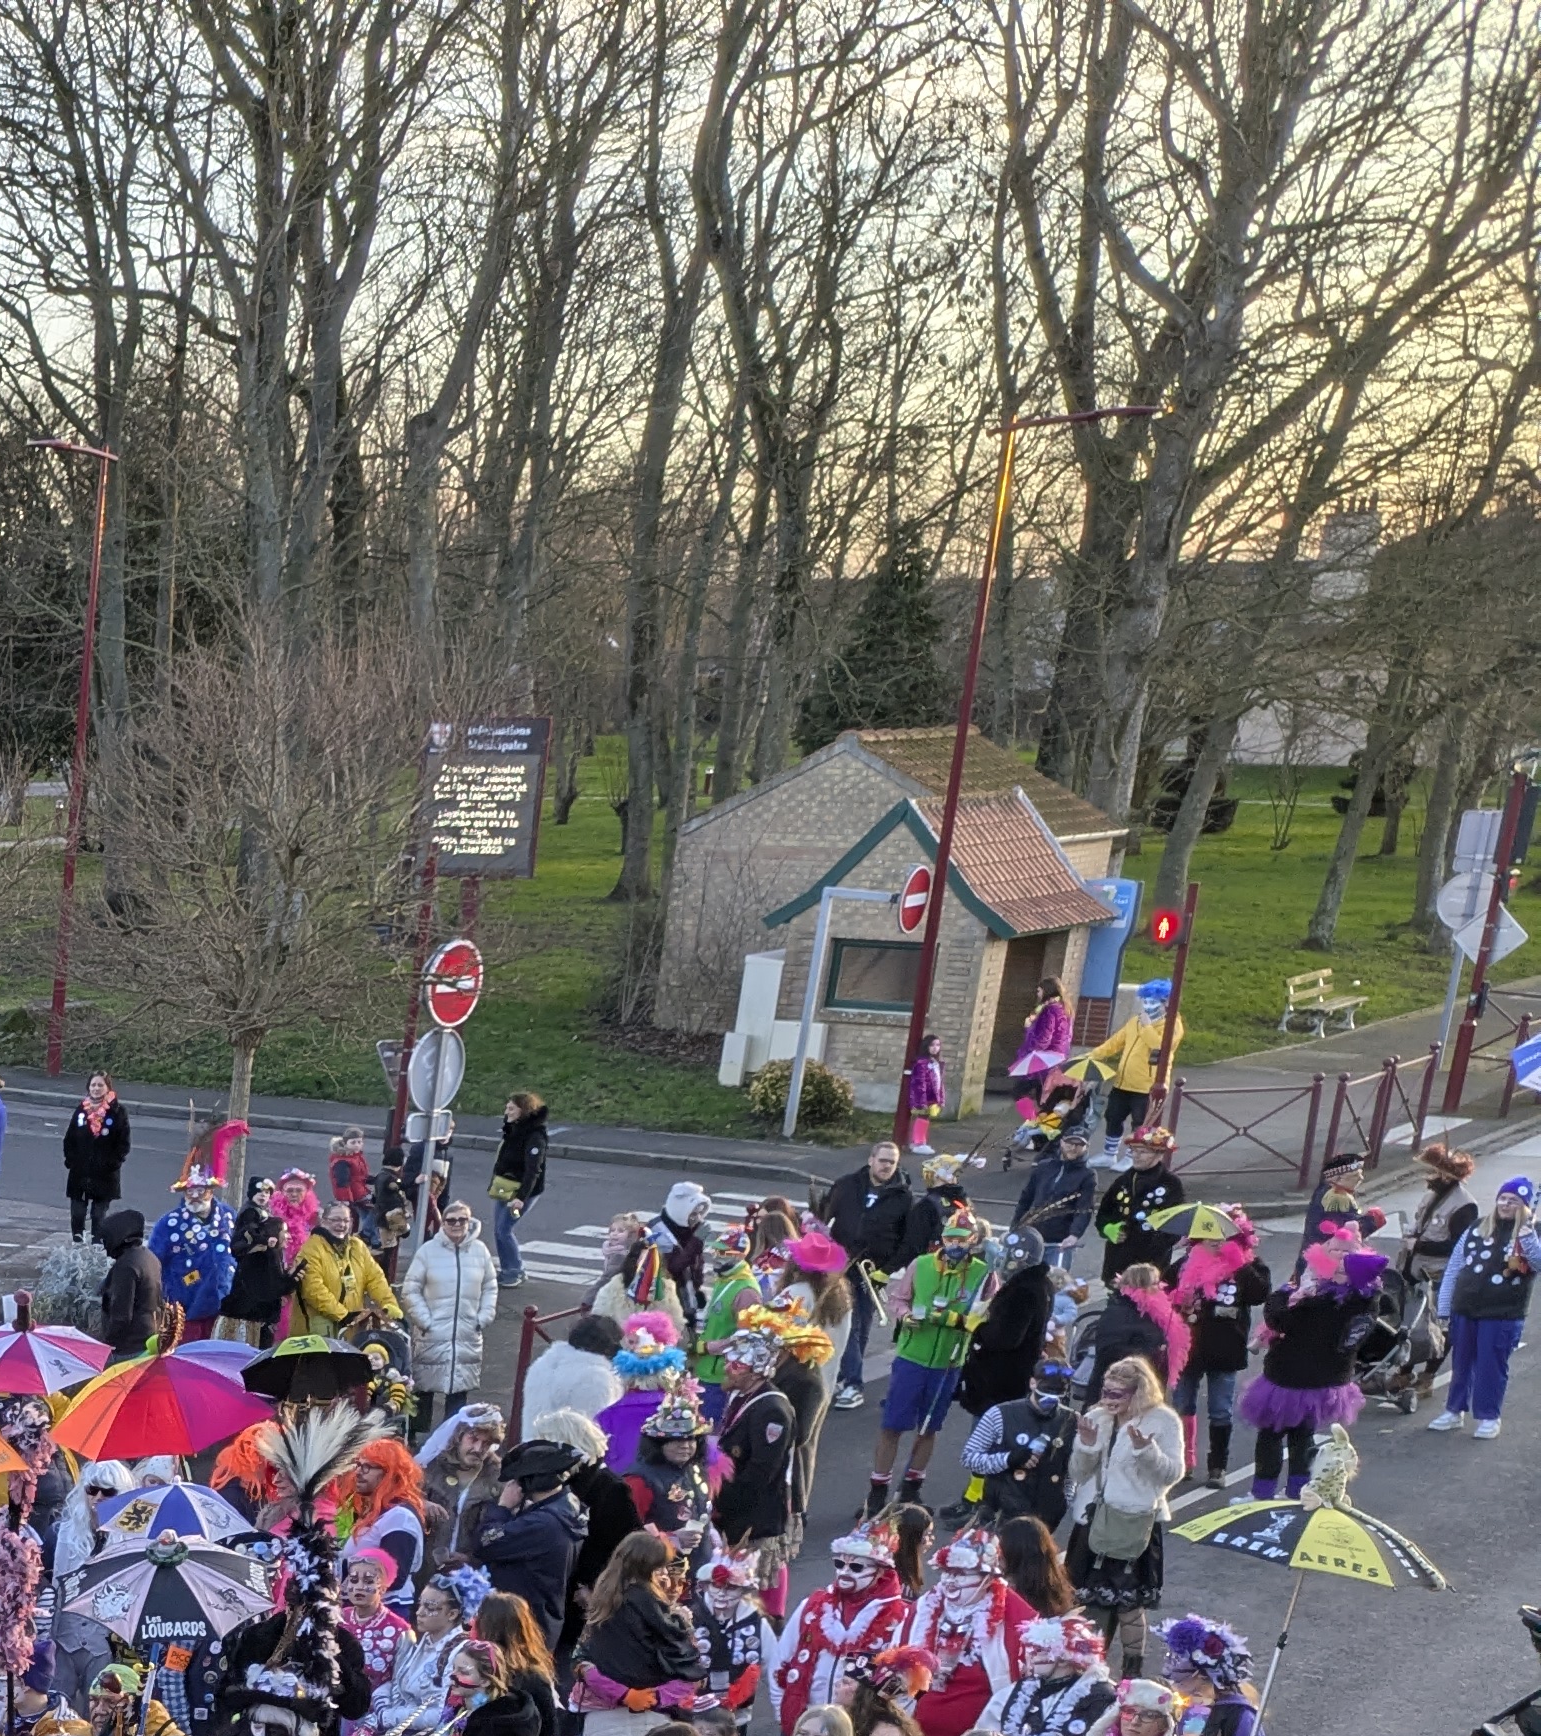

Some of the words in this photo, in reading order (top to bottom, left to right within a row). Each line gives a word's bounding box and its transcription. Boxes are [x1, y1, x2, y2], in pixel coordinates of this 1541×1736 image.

[1299, 1551, 1379, 1578] AERES
[146, 1616, 162, 1624] Les
[142, 1621, 207, 1640] LOUBARDS
